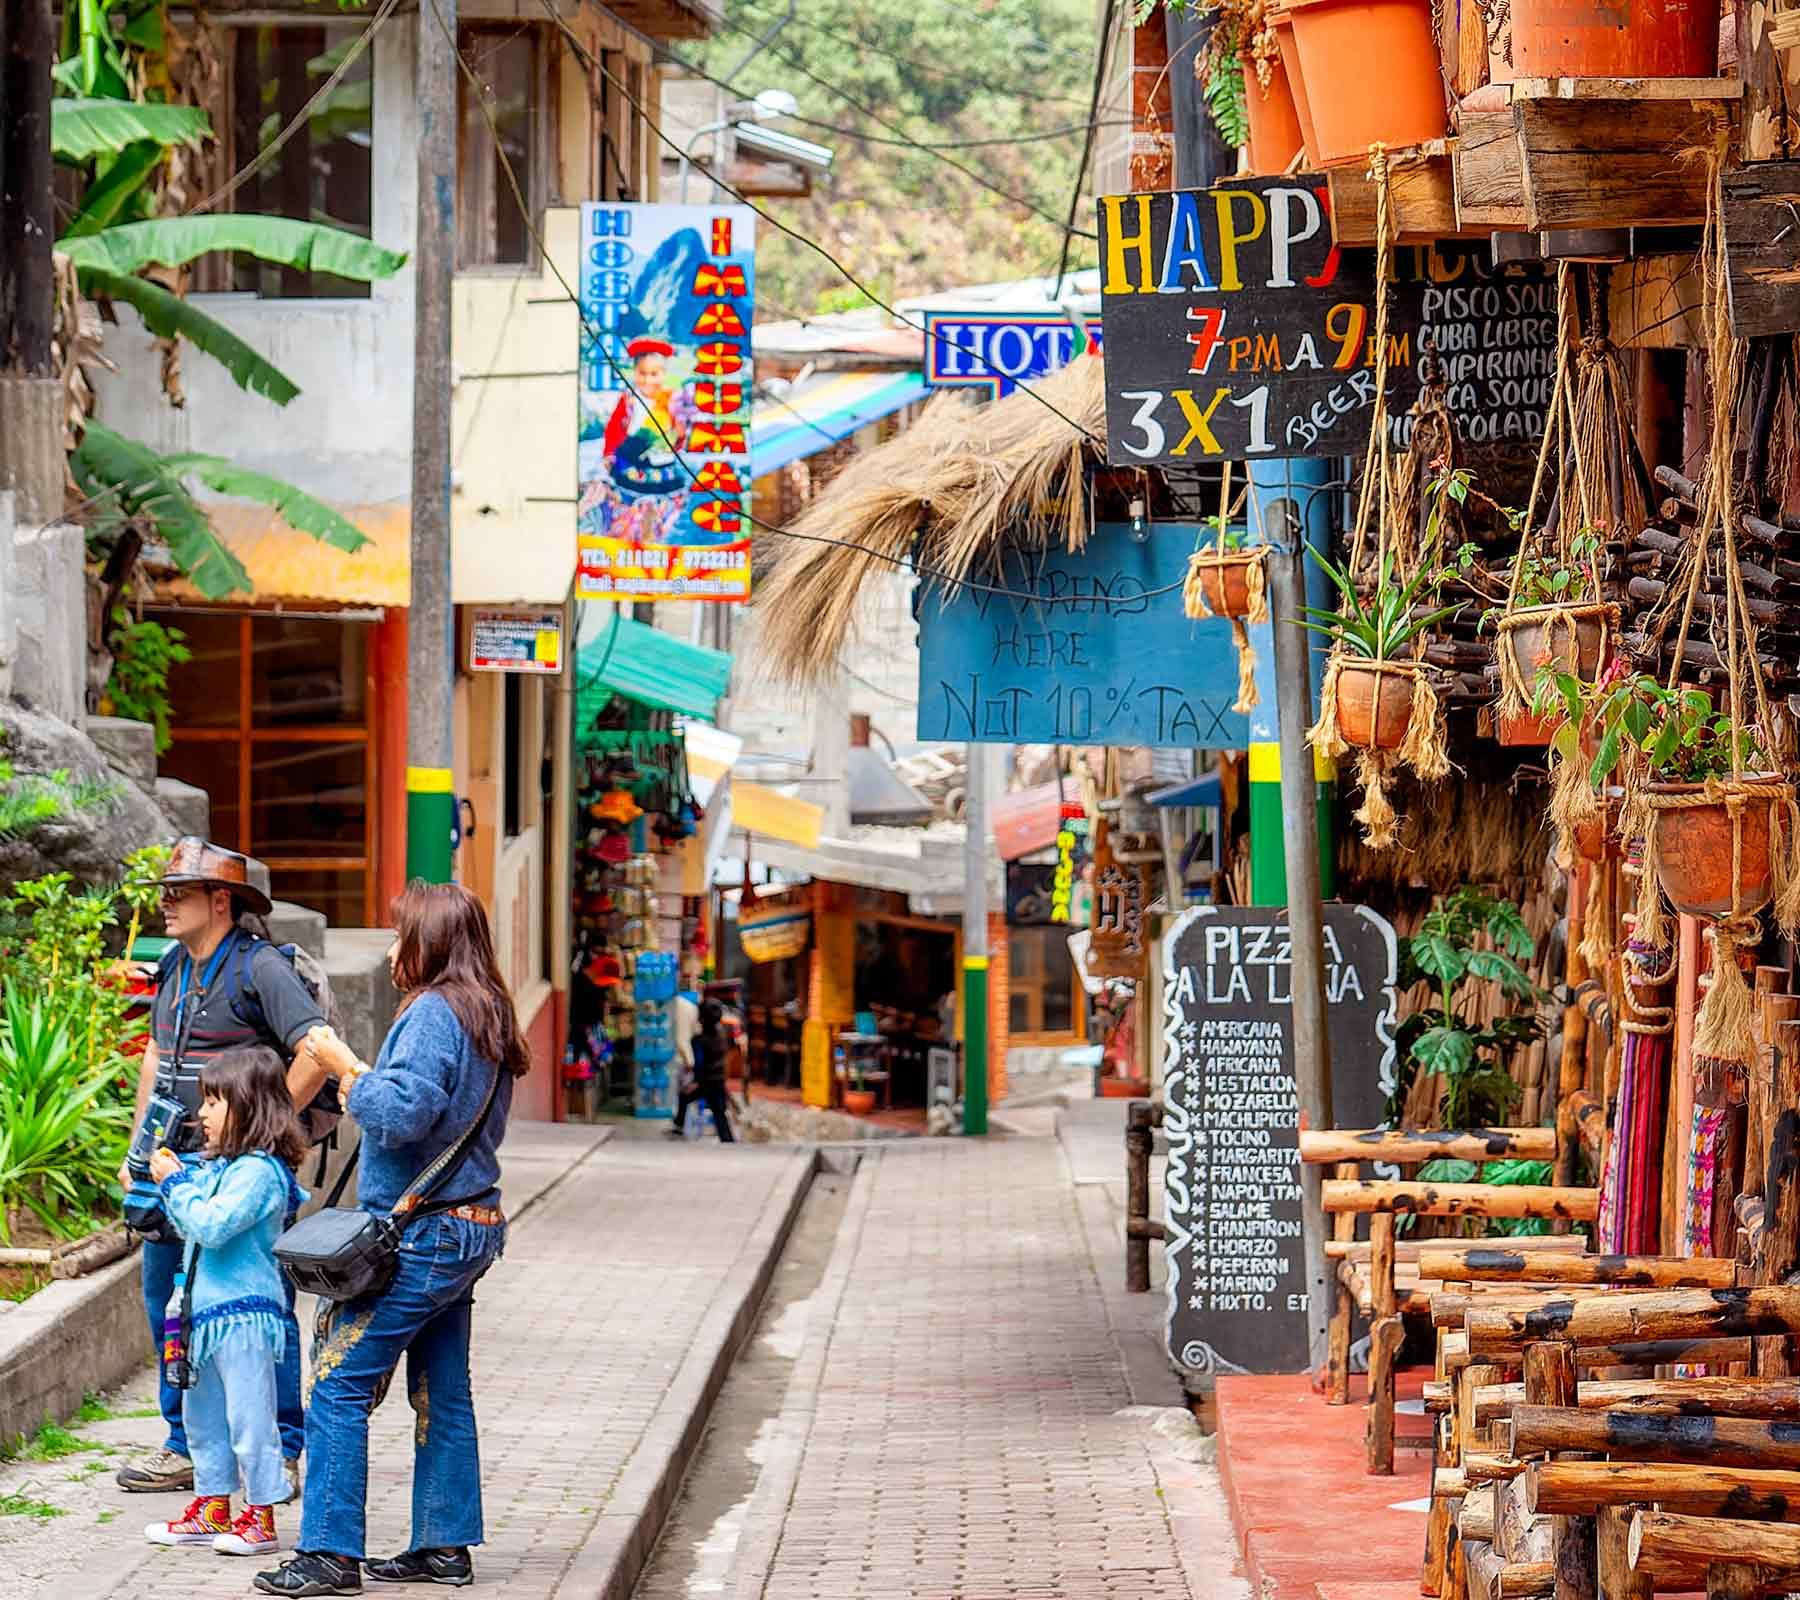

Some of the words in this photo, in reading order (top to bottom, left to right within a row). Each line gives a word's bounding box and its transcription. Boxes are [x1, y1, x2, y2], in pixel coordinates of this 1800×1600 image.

[589, 210, 634, 391] HOSTAL
[1422, 286, 1500, 321] PISCO
[1506, 284, 1556, 316] SOU
[1417, 322, 1477, 353] CUBA
[1483, 319, 1556, 349] LIBRE
[687, 217, 748, 534] IMASUMAC
[1286, 368, 1397, 450] BEER
[1456, 411, 1543, 442] COLAD
[992, 624, 1089, 667] HERE
[1138, 685, 1233, 742] TAX
[1206, 964, 1252, 1004] LA
[1200, 1020, 1282, 1039] AMERICANA
[1200, 1039, 1283, 1056] HAWAYANA
[1205, 1057, 1281, 1074] AFRICANA
[1204, 1093, 1298, 1111] MOZARELLA
[1209, 1129, 1271, 1147] TOCINO
[1212, 1147, 1302, 1165] MARGARITA
[1210, 1166, 1294, 1183] FRANCESA
[1209, 1202, 1272, 1219] SALAME
[1209, 1238, 1278, 1256] CHORIZO
[1210, 1257, 1290, 1275] PEPERONI
[1210, 1275, 1278, 1292] MARINO
